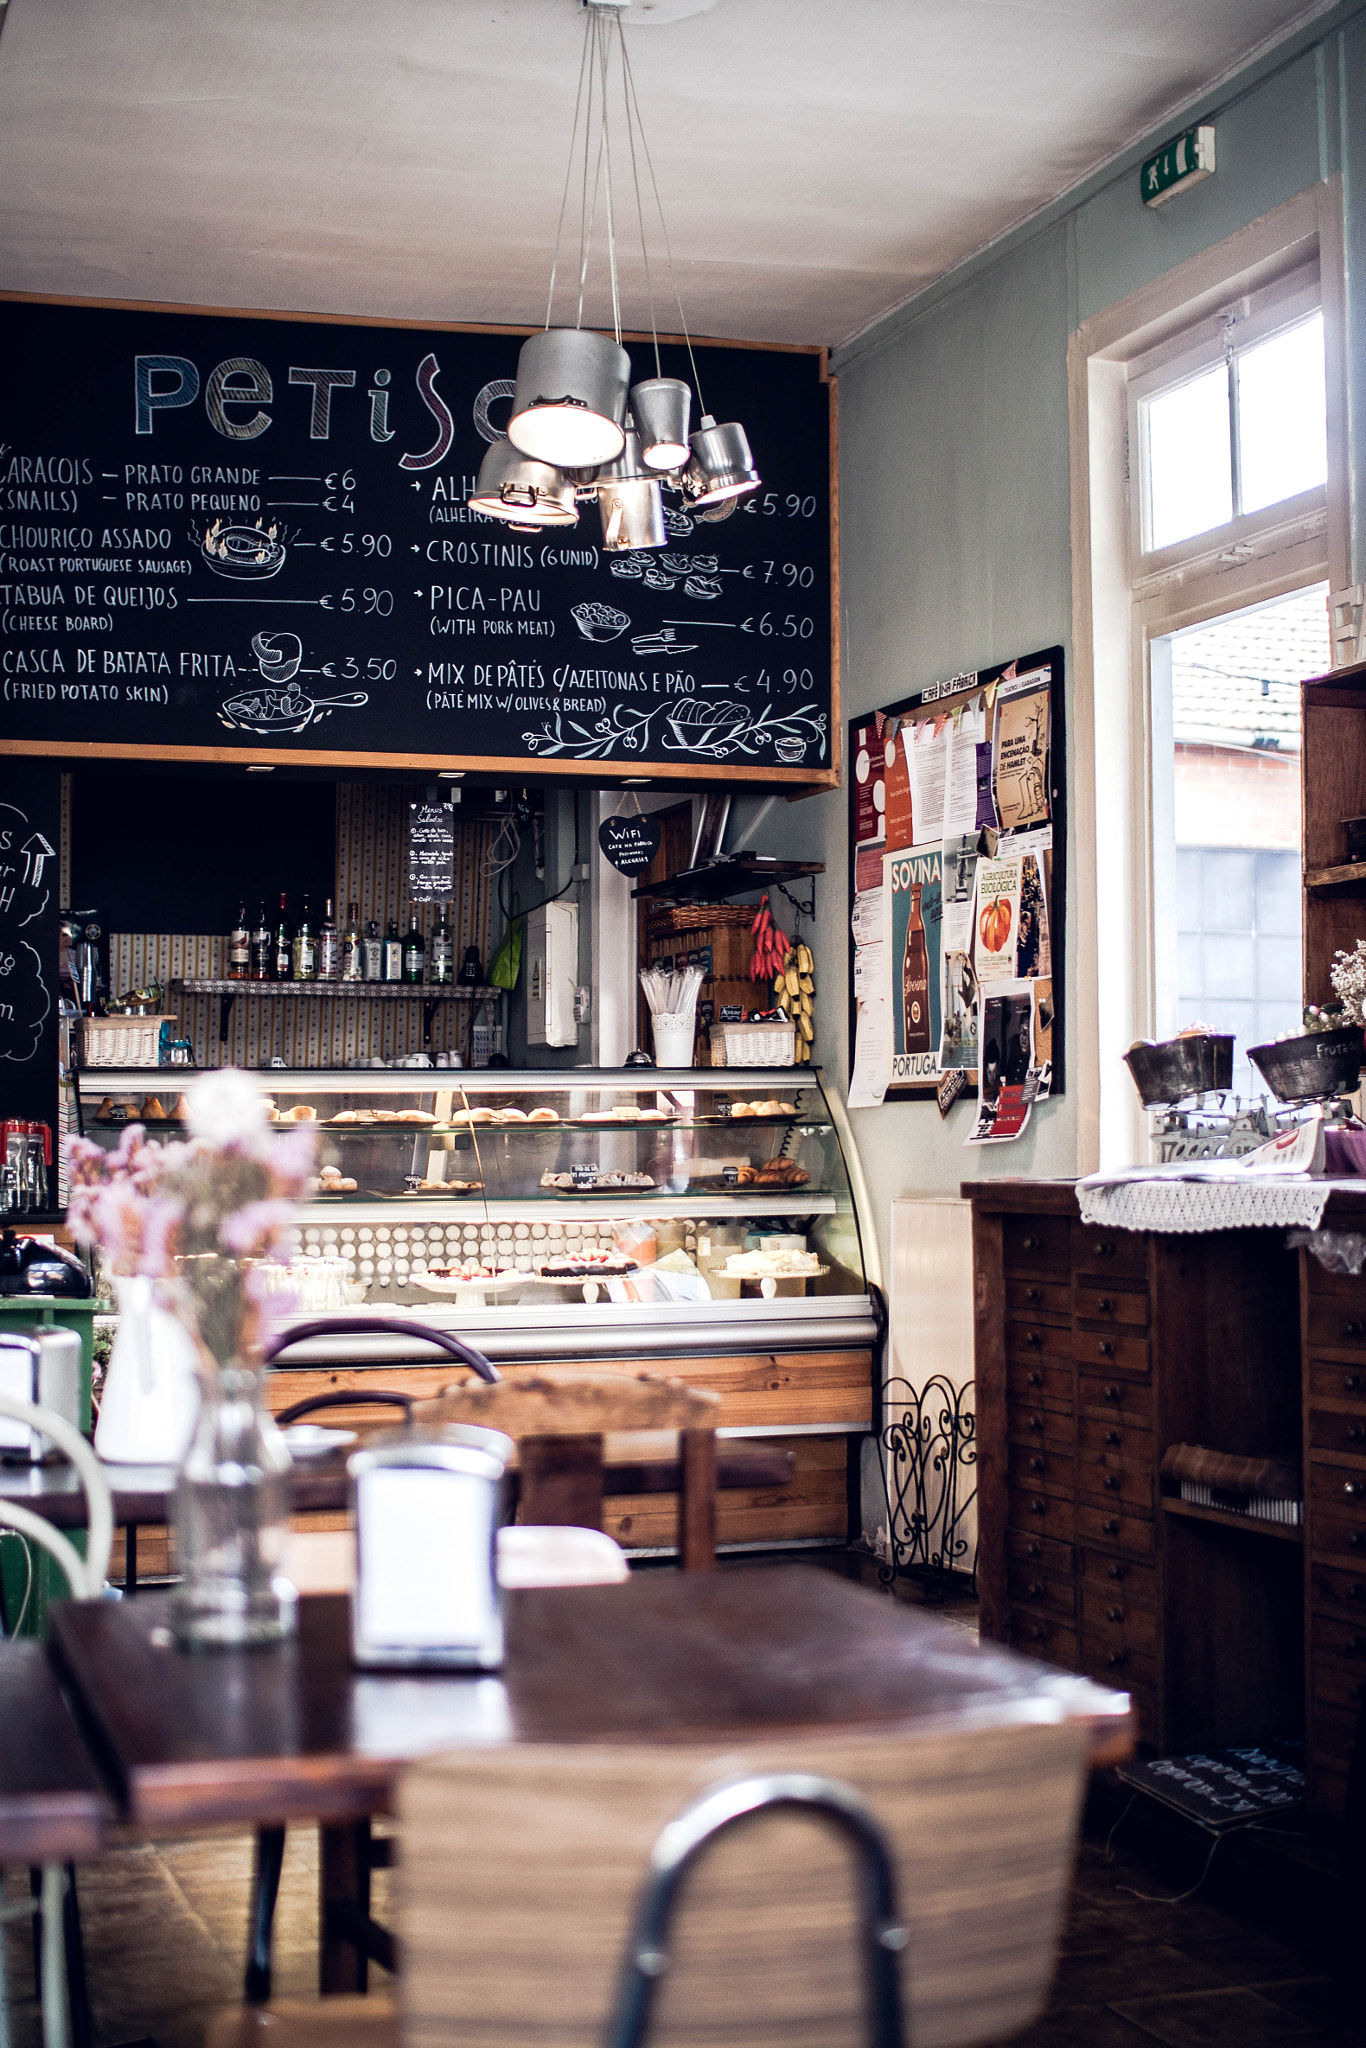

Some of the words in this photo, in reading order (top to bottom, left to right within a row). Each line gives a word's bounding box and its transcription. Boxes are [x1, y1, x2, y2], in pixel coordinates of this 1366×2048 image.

[124, 464, 182, 484] PRATO
[190, 466, 260, 484] GRANDE
[126, 492, 184, 510] PRATO
[192, 494, 260, 512] PEQUENO
[0, 524, 92, 552] CHOURIÇO
[102, 528, 172, 550] ASSADO
[60, 558, 132, 572] PORTUGUESE
[138, 560, 192, 574] SAUSAGE)
[426, 540, 534, 568] CROSTINIS
[74, 586, 96, 606] DE
[104, 586, 178, 610] QUEIJOS
[430, 586, 540, 612] PICA-PAU
[2, 608, 58, 634] (CHEESE
[66, 614, 114, 632] BOARD)
[430, 616, 476, 636] (WITH
[482, 620, 514, 634] PORK
[518, 620, 556, 638] MEAT)
[2, 648, 66, 672] CASCA
[78, 648, 96, 672] DE
[104, 650, 172, 674] BATATA
[180, 652, 236, 678] FRITA
[4, 678, 56, 700] (FRIED
[60, 684, 118, 700] POTATO
[126, 684, 168, 704] SKIN)
[428, 662, 464, 684] MIX
[474, 664, 492, 686] DE
[652, 672, 660, 692] E
[666, 670, 696, 694] PÃO
[468, 694, 492, 710] MIX
[892, 854, 941, 893] SOVINA
[892, 1054, 942, 1076] PORTUGA
